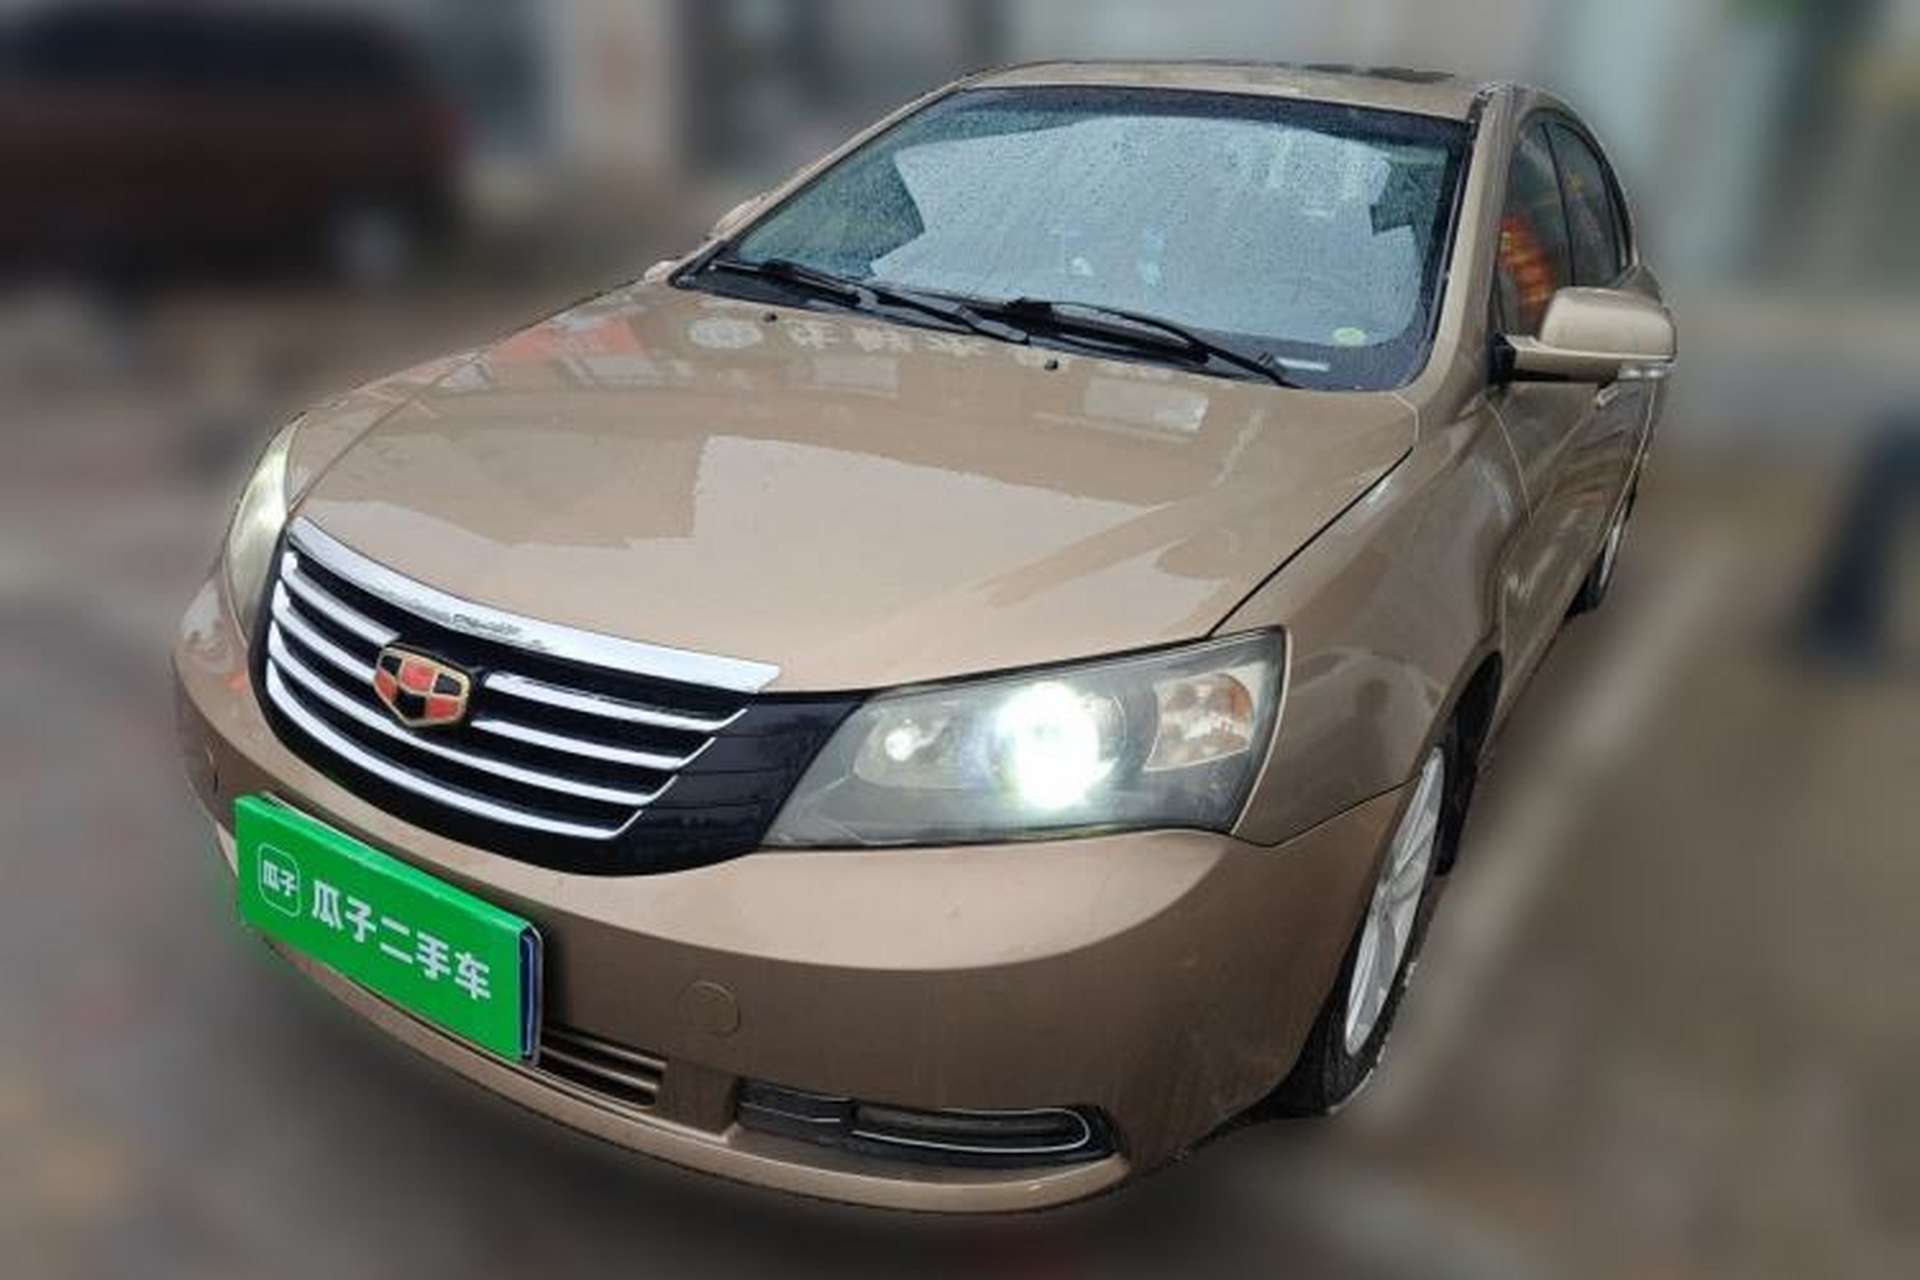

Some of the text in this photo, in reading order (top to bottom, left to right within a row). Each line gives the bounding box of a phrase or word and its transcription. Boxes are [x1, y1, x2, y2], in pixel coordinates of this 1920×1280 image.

[262, 861, 298, 897] 瓜子
[312, 880, 491, 1000] 瓜子二手车
